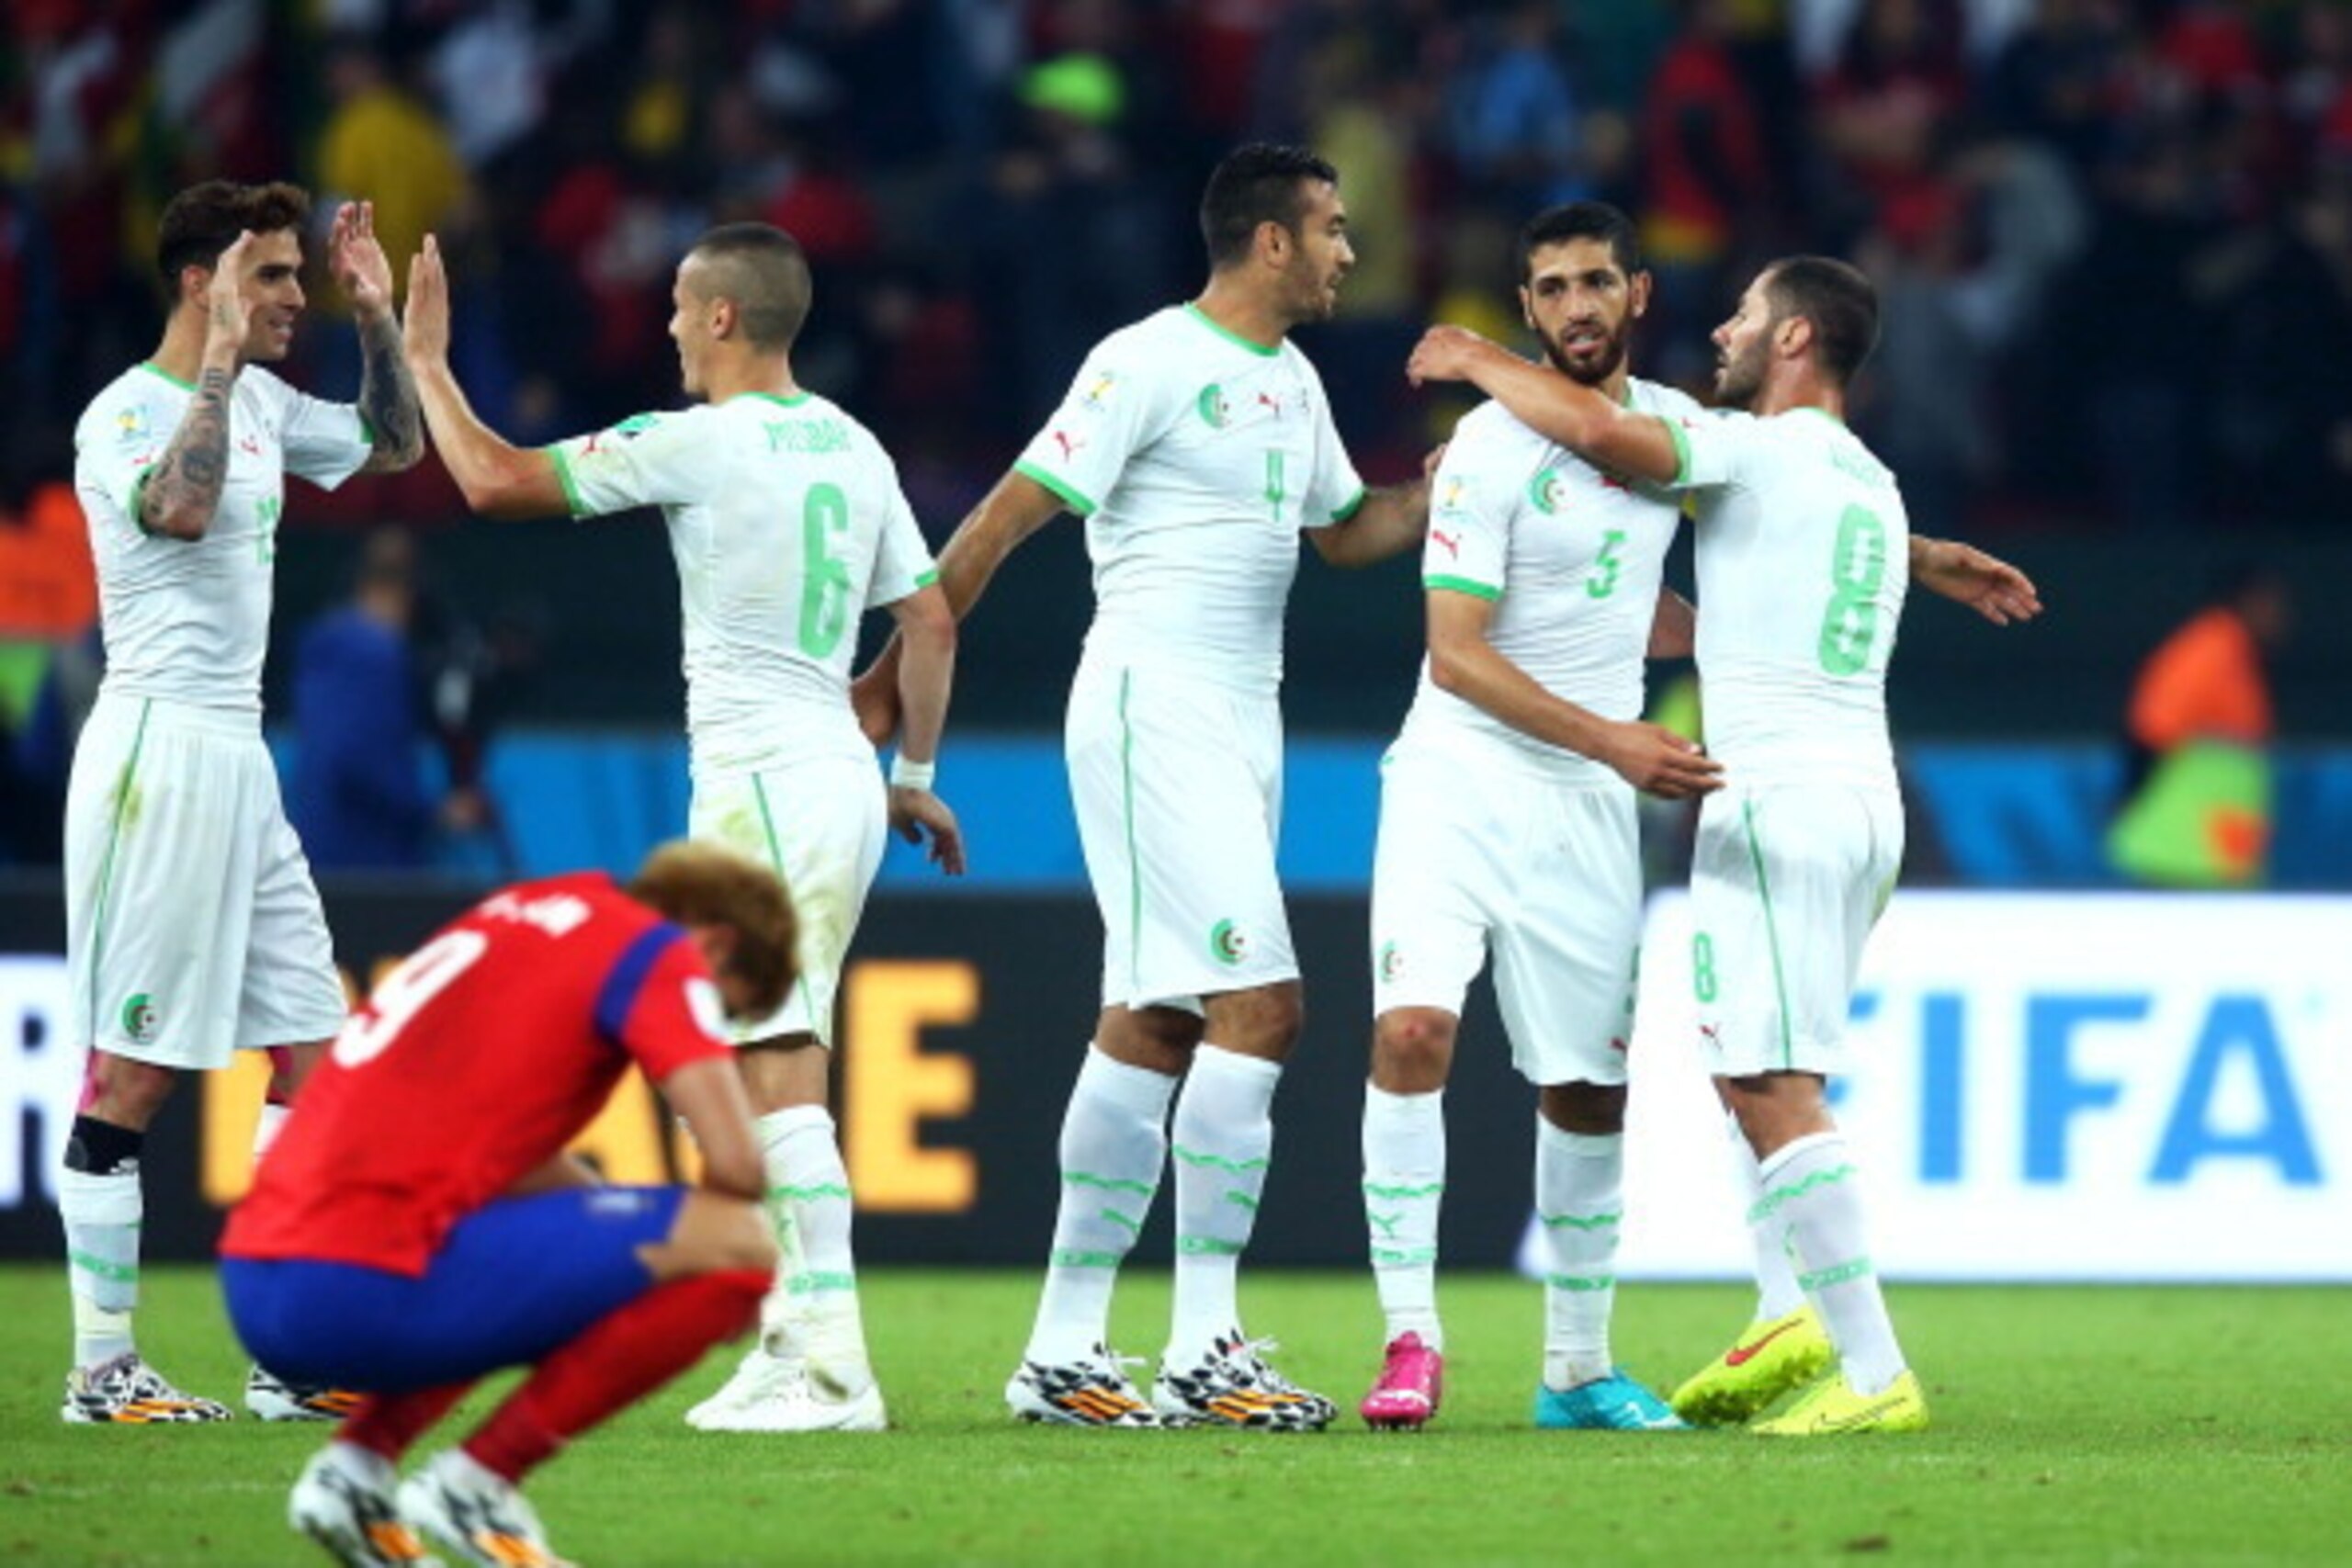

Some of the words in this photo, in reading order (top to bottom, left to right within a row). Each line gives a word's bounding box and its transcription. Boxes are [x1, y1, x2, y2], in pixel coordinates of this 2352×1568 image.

[1264, 447, 1284, 525] 4
[798, 481, 849, 660] 6
[1817, 502, 1886, 678] 8
[332, 926, 489, 1070] 9
[1692, 931, 1717, 1003] 8
[1825, 992, 2326, 1187] IFA
